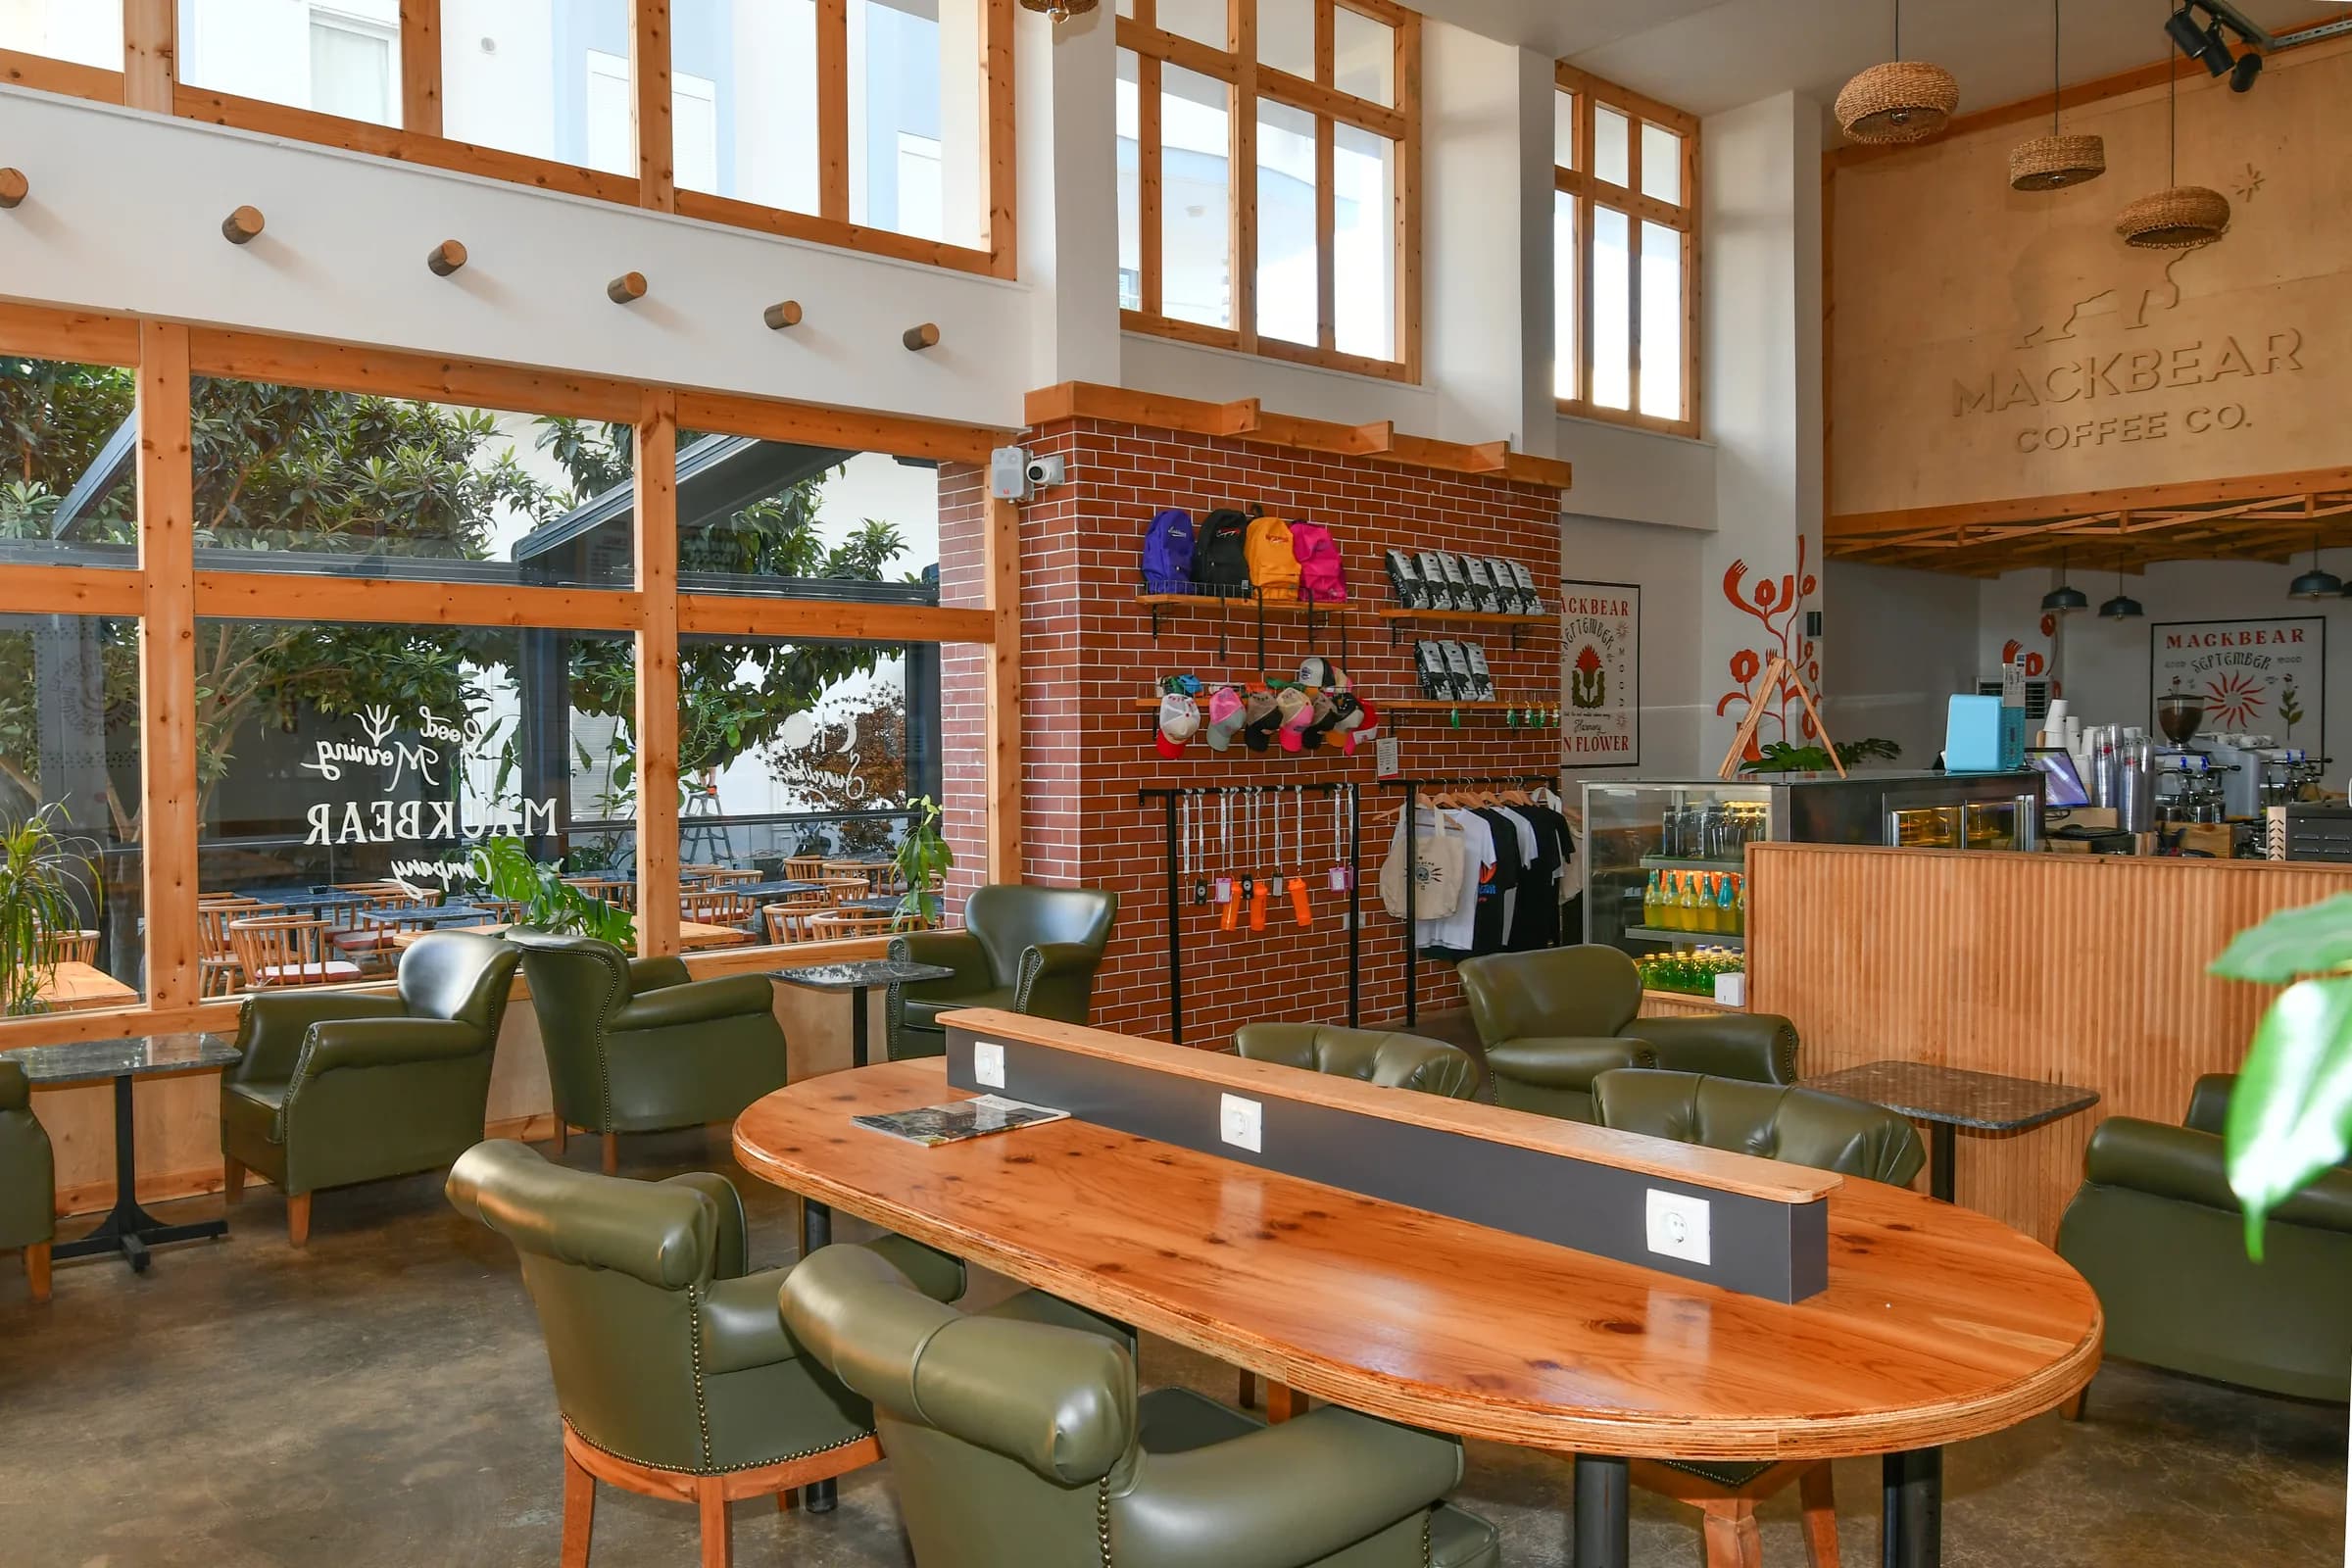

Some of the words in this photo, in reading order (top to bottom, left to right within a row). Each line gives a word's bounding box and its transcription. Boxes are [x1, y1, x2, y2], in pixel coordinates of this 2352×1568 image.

[1951, 327, 2305, 418] MACKBEAR
[2016, 411, 2169, 454] COFFEE
[2185, 402, 2253, 434] CO.
[1560, 597, 1629, 616] ACKBEAR
[2166, 627, 2306, 650] MACKBEAR
[2189, 651, 2273, 674] SEPTEMBER
[1575, 735, 1629, 753] FLOWER
